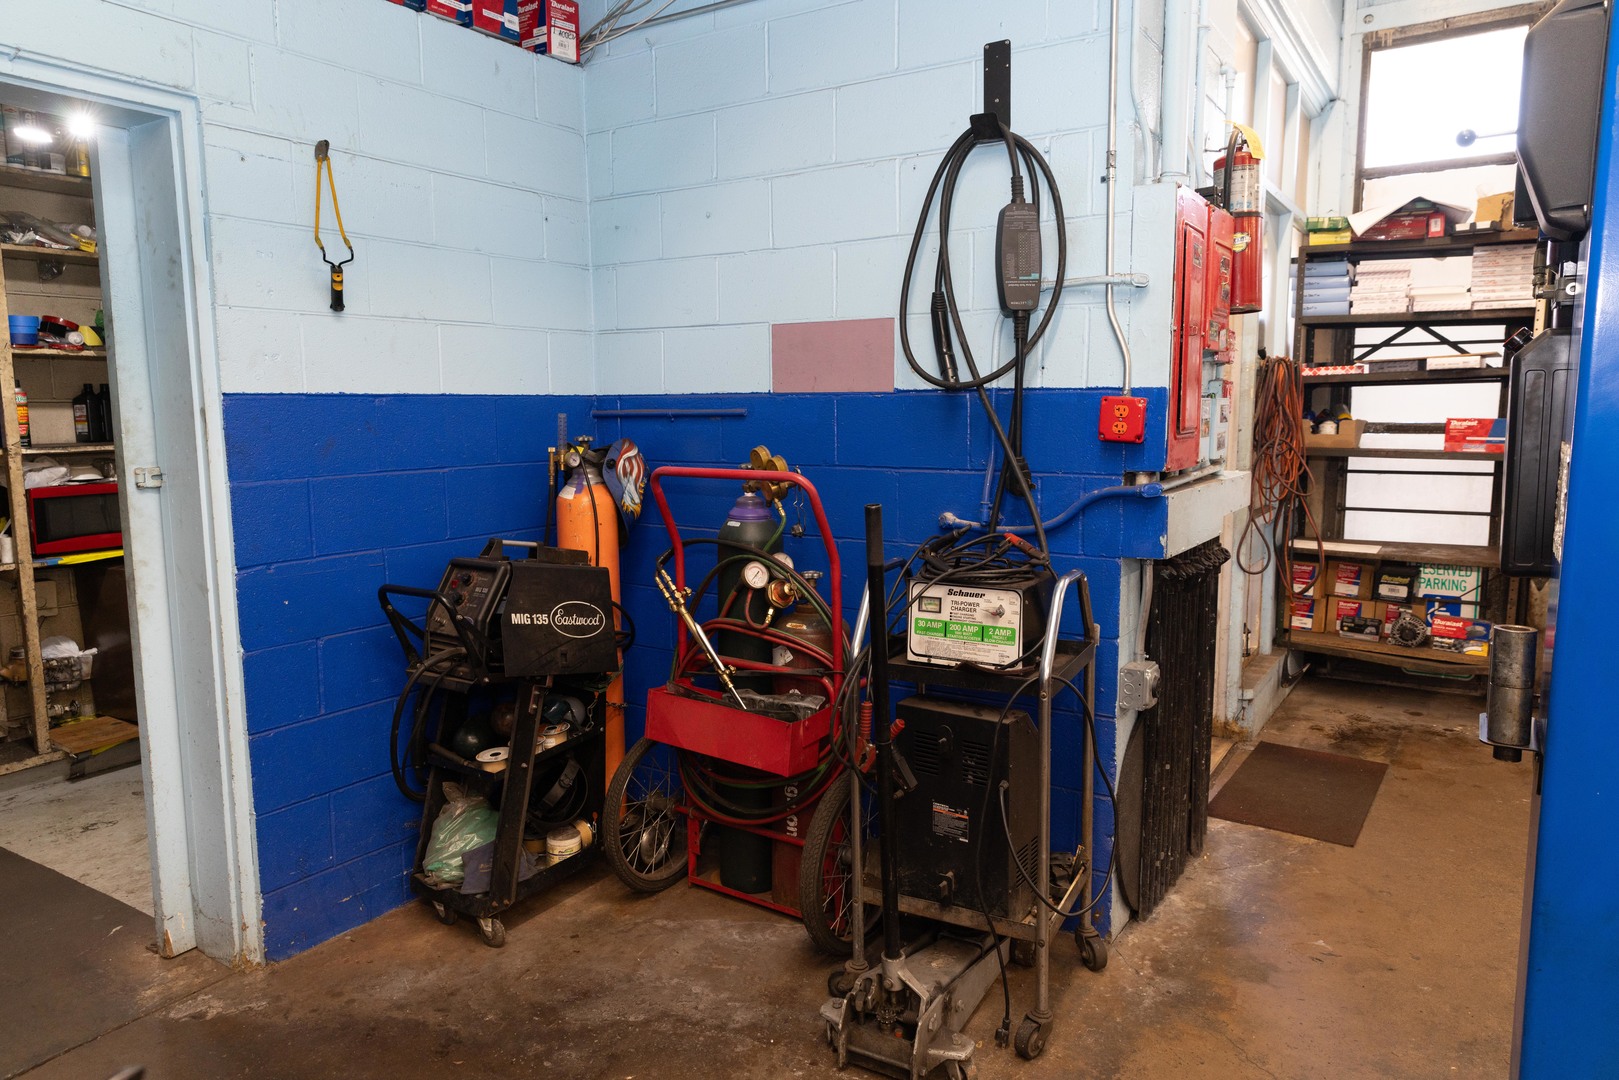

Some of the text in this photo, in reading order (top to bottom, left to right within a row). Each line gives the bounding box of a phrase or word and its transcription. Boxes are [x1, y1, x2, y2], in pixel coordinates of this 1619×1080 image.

[551, 0, 576, 13] Duralast
[1420, 563, 1473, 578] ESERVED
[1418, 577, 1467, 592] PARKING
[947, 589, 986, 599] Schauer
[511, 613, 549, 625] MIG 135
[555, 609, 601, 626] Eastwood
[926, 621, 943, 629] AMP
[962, 625, 979, 633] AMP
[1433, 619, 1464, 628] Duralast
[994, 629, 1012, 637] AMP
